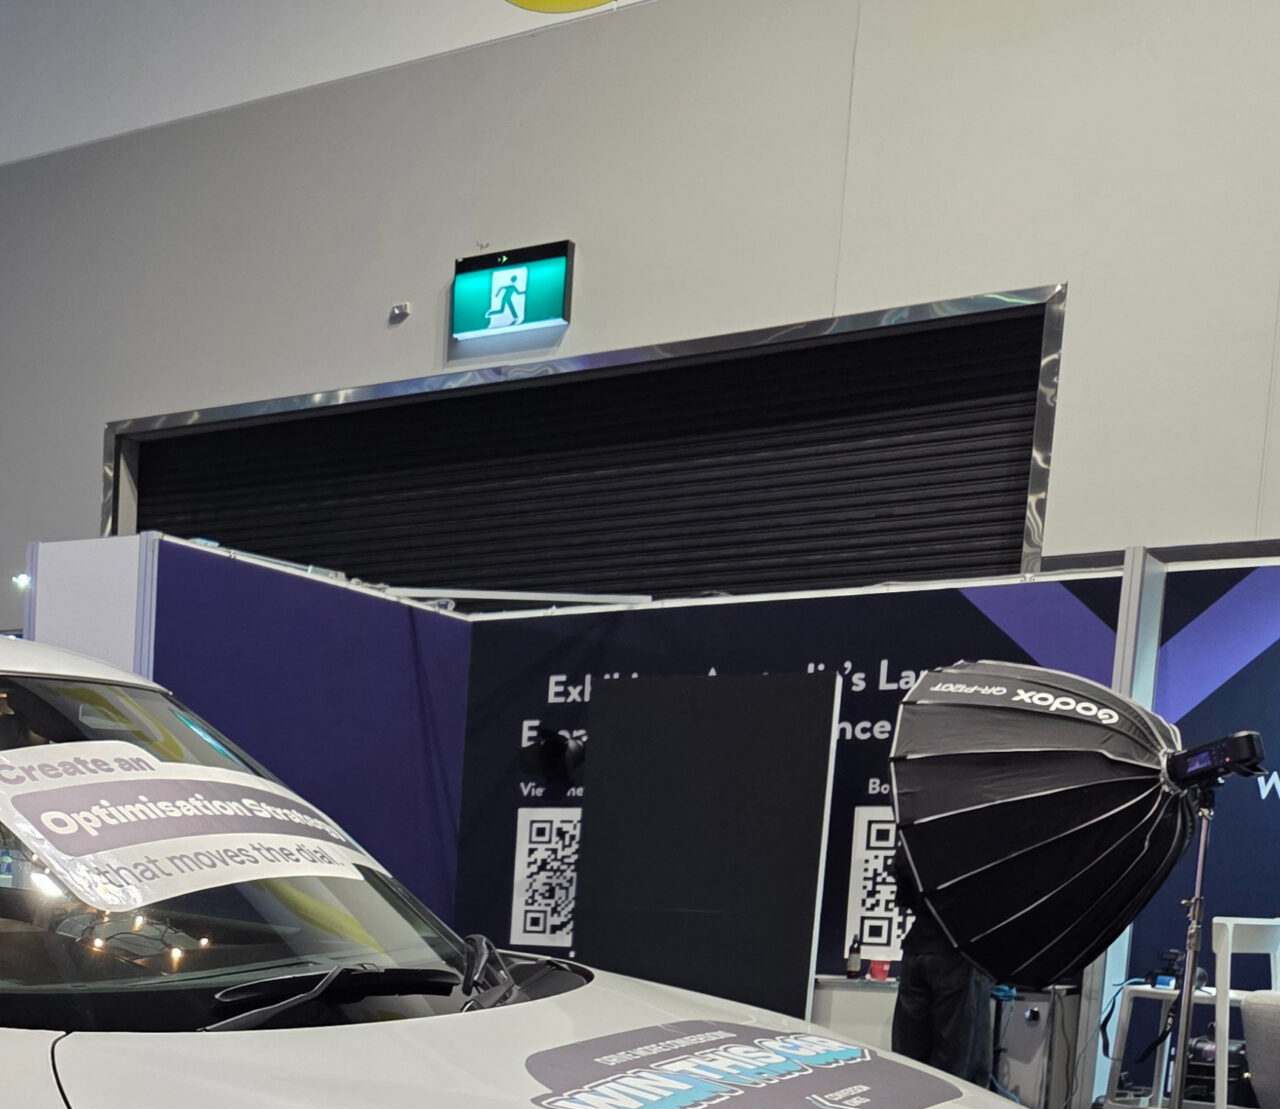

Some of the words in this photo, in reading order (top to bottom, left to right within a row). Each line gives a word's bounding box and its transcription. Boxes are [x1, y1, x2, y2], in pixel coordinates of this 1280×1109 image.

[112, 754, 155, 772] an
[40, 795, 247, 837] Optimisation
[95, 856, 172, 888] that
[166, 847, 260, 873] moves
[251, 842, 301, 864] the
[665, 1045, 805, 1084] THIS
[768, 1034, 868, 1067] CAR
